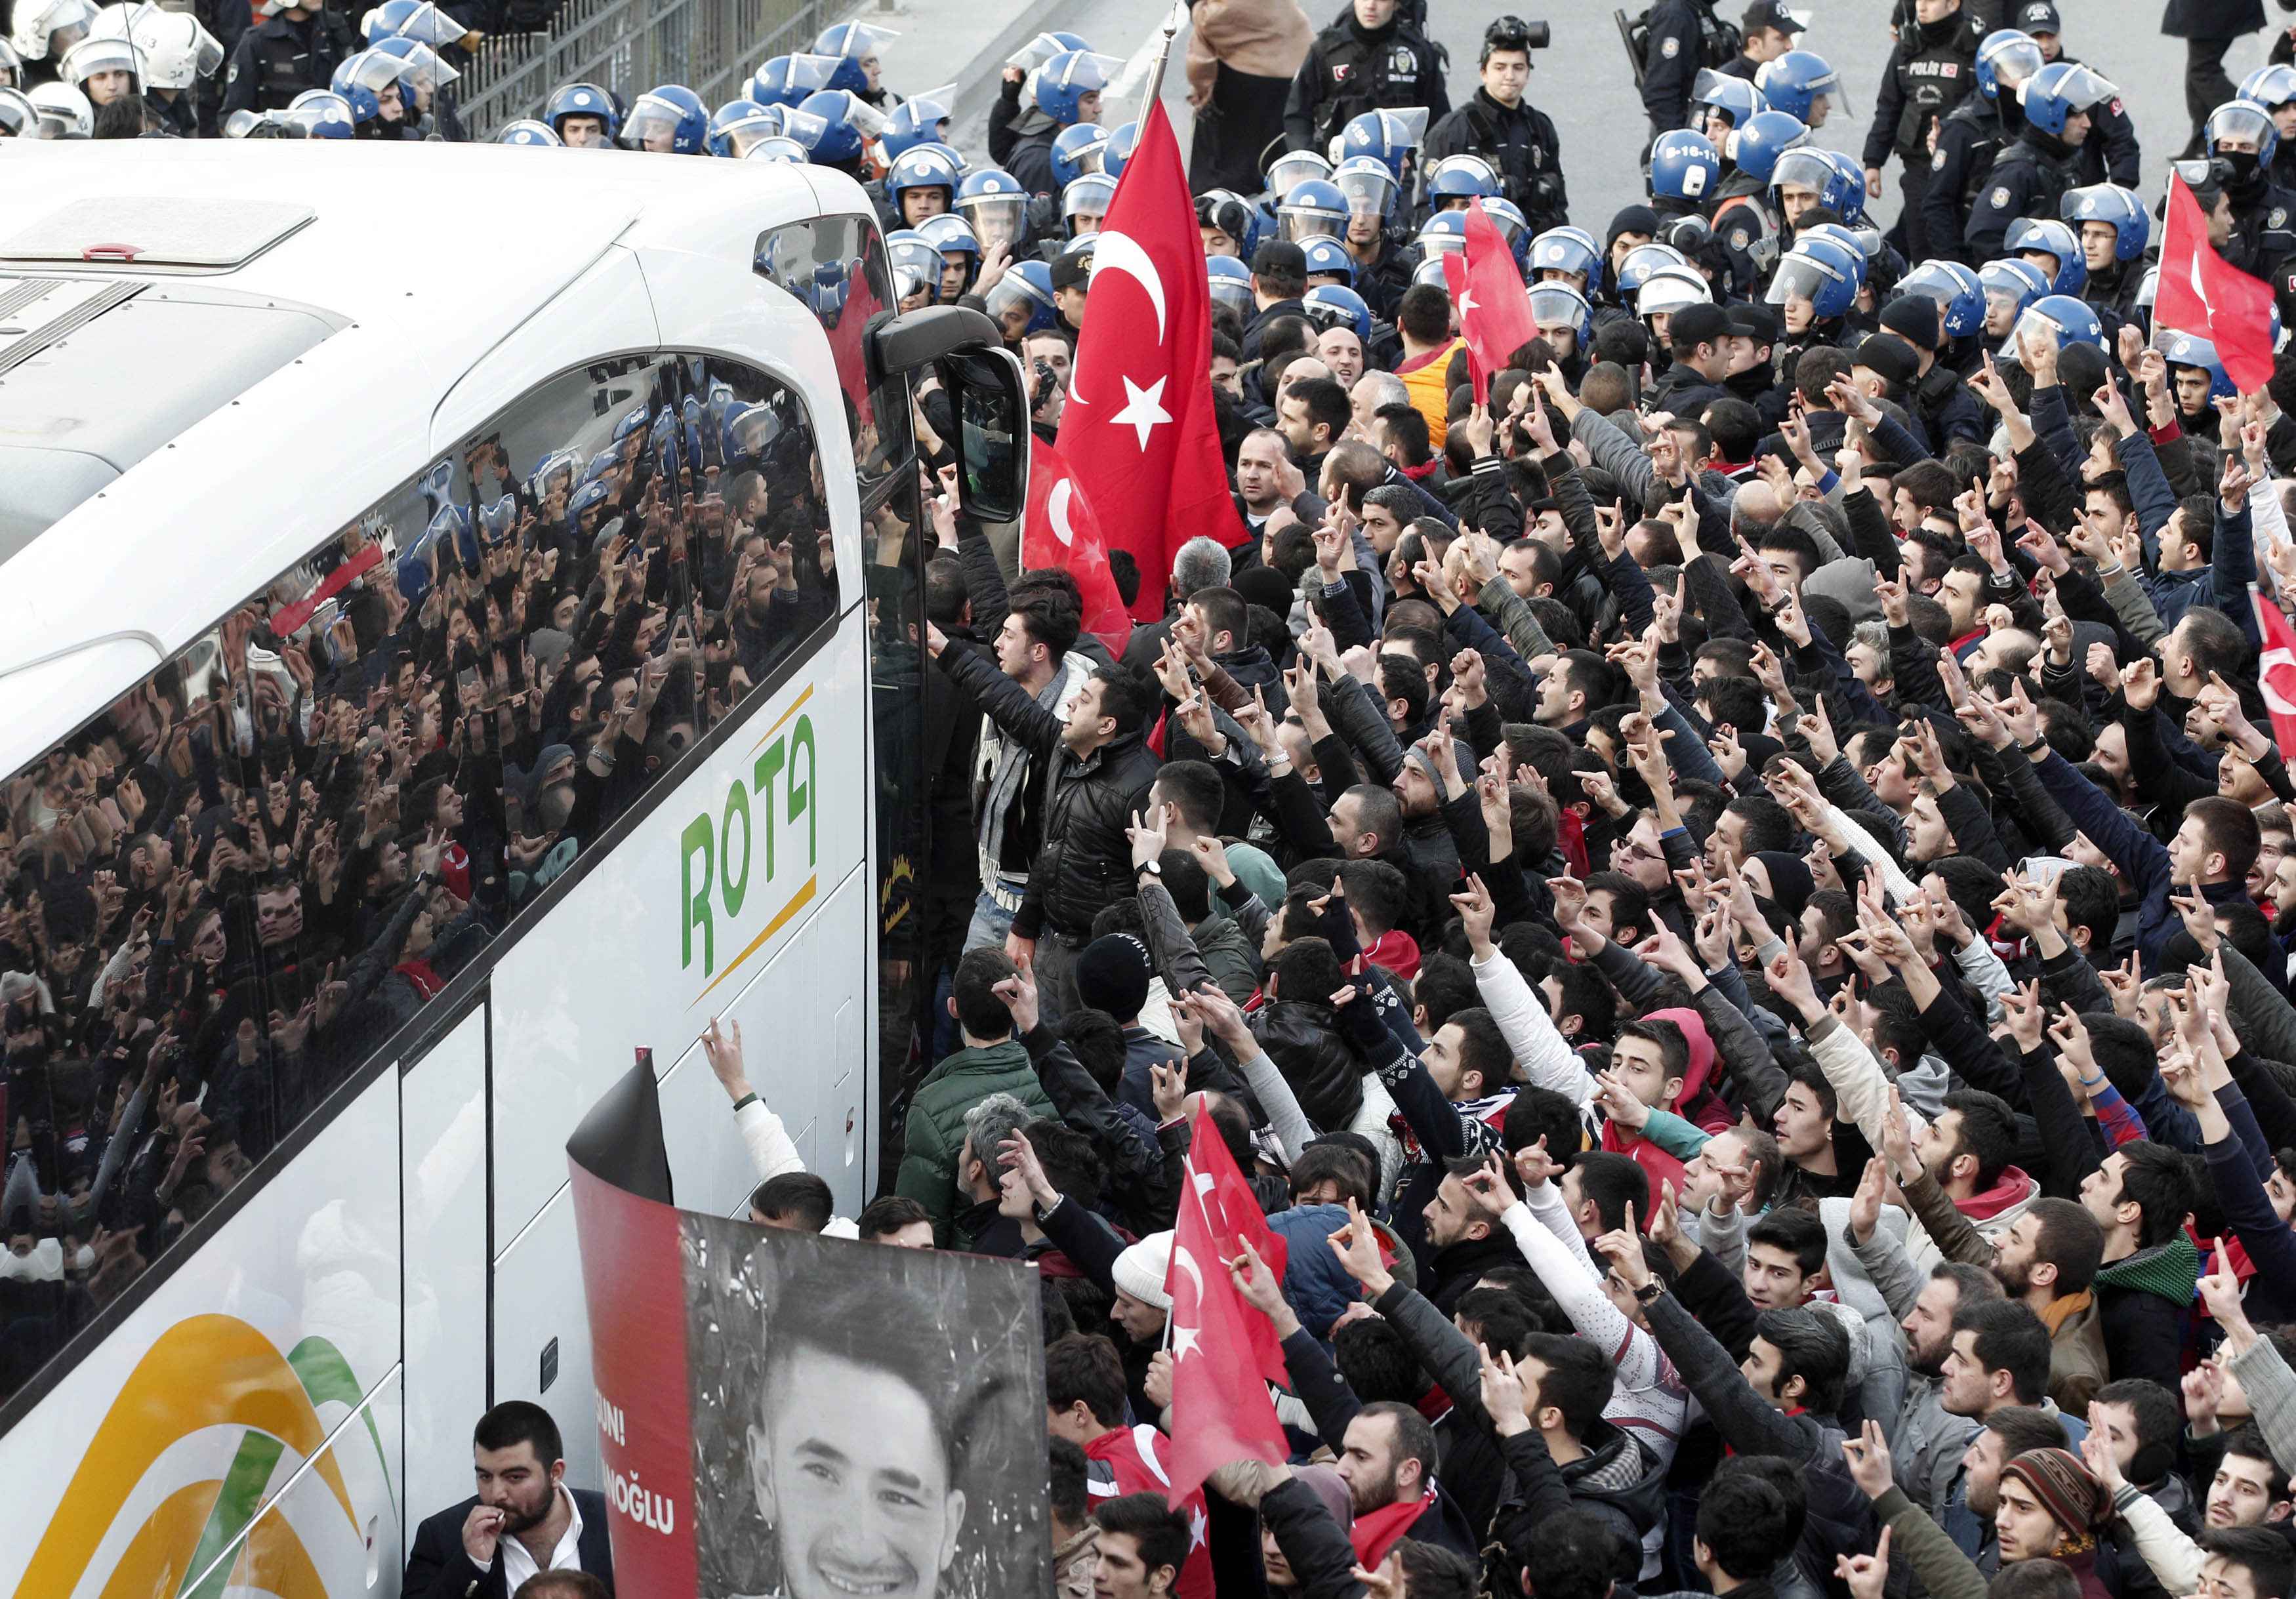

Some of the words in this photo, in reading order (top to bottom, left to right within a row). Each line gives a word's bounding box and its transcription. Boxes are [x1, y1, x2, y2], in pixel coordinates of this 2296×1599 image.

[1910, 61, 1940, 75] POLİS
[675, 138, 689, 147] 34
[1822, 192, 1835, 205] 34
[1845, 207, 1857, 220] 34
[681, 713, 817, 980] ROTA
[602, 1461, 674, 1535] NOĞLU
